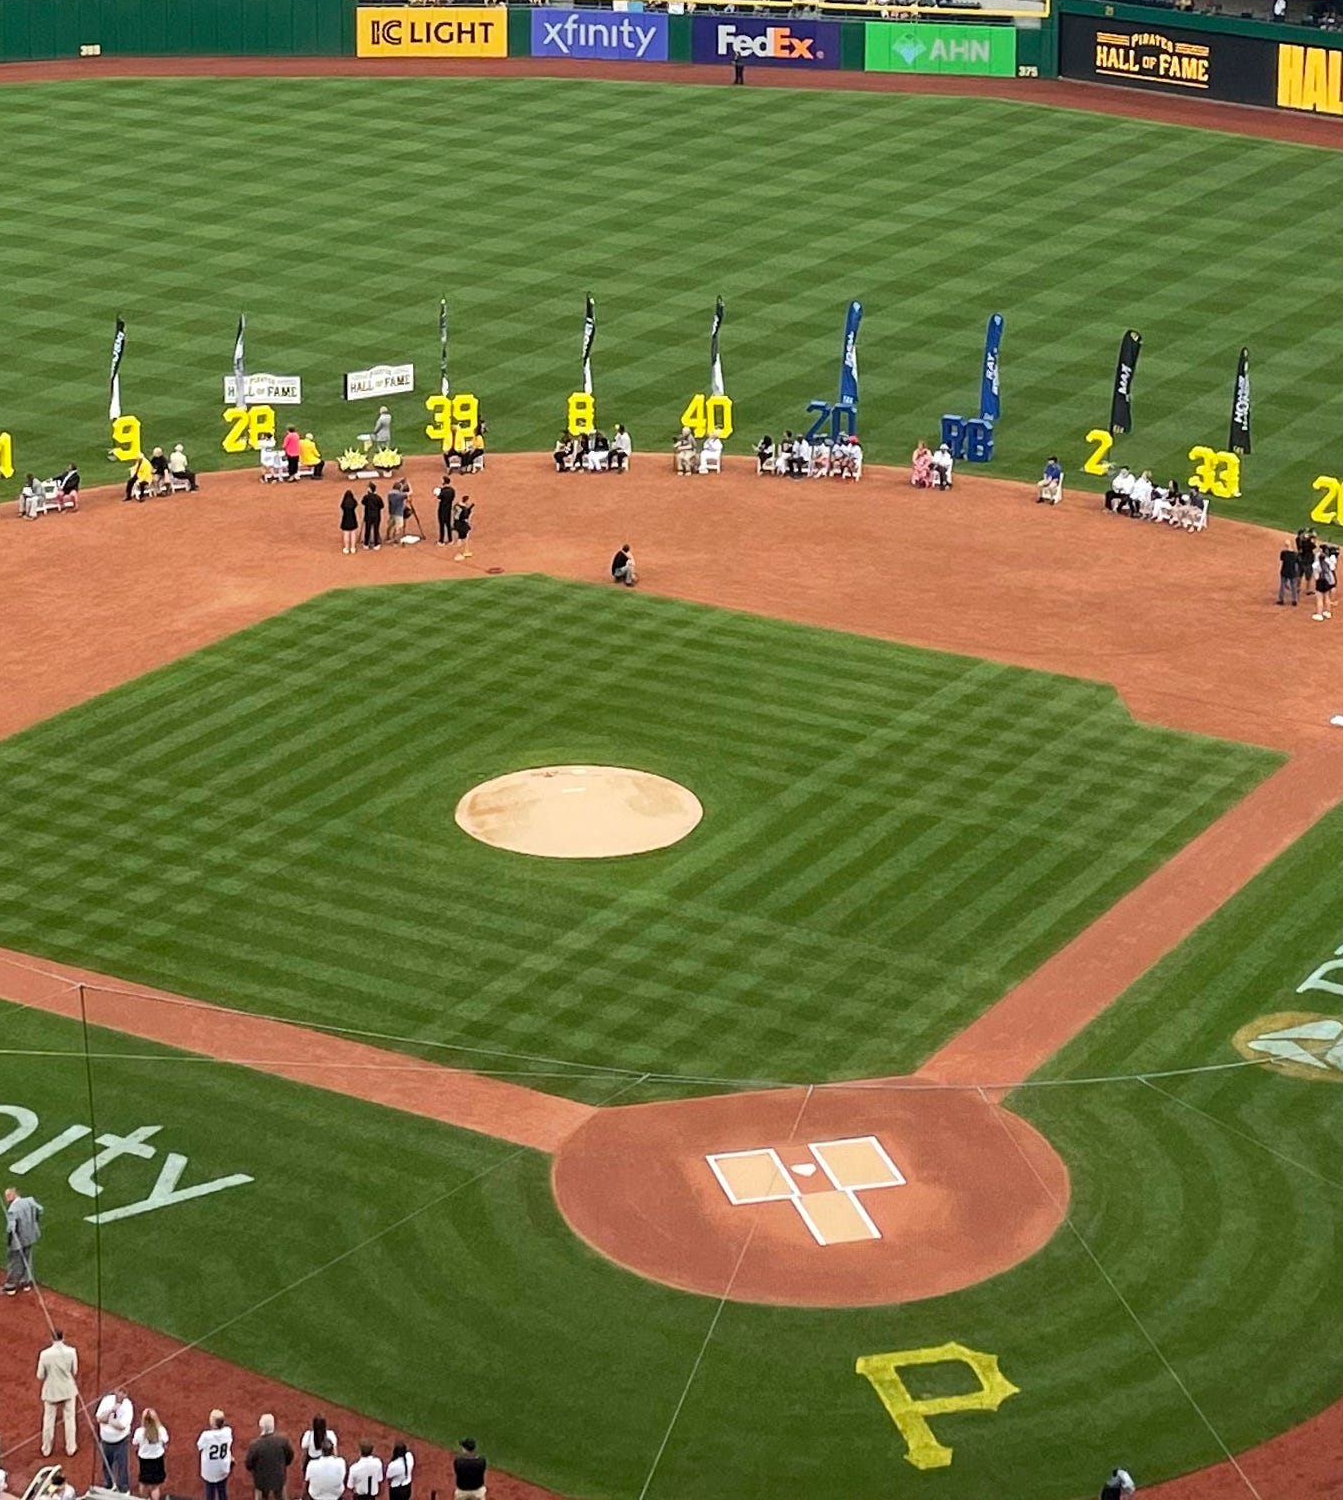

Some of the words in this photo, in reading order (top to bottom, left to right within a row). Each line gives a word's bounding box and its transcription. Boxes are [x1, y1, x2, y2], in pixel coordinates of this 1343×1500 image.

[371, 20, 404, 46] IC
[409, 21, 494, 44] LIGHT
[542, 13, 657, 57] xfinity
[717, 25, 815, 59] FedEx
[928, 39, 991, 64] AHN
[1131, 32, 1174, 54] PIRATES
[1019, 66, 1039, 78] 375
[1095, 45, 1140, 73] HALL
[1142, 55, 1158, 71] OF
[1159, 53, 1209, 82] FAME
[267, 386, 298, 398] FAME
[350, 380, 375, 393] HALL
[385, 374, 410, 388] FAME
[222, 404, 276, 452] 28
[424, 393, 477, 440] 39
[567, 392, 595, 437] 8
[680, 393, 733, 439] 40
[806, 399, 858, 443] 20
[112, 415, 141, 461] 9
[1084, 429, 1113, 476] 2
[1188, 445, 1241, 499] 33
[856, 1340, 1021, 1470] P
[209, 1442, 228, 1461] 28
